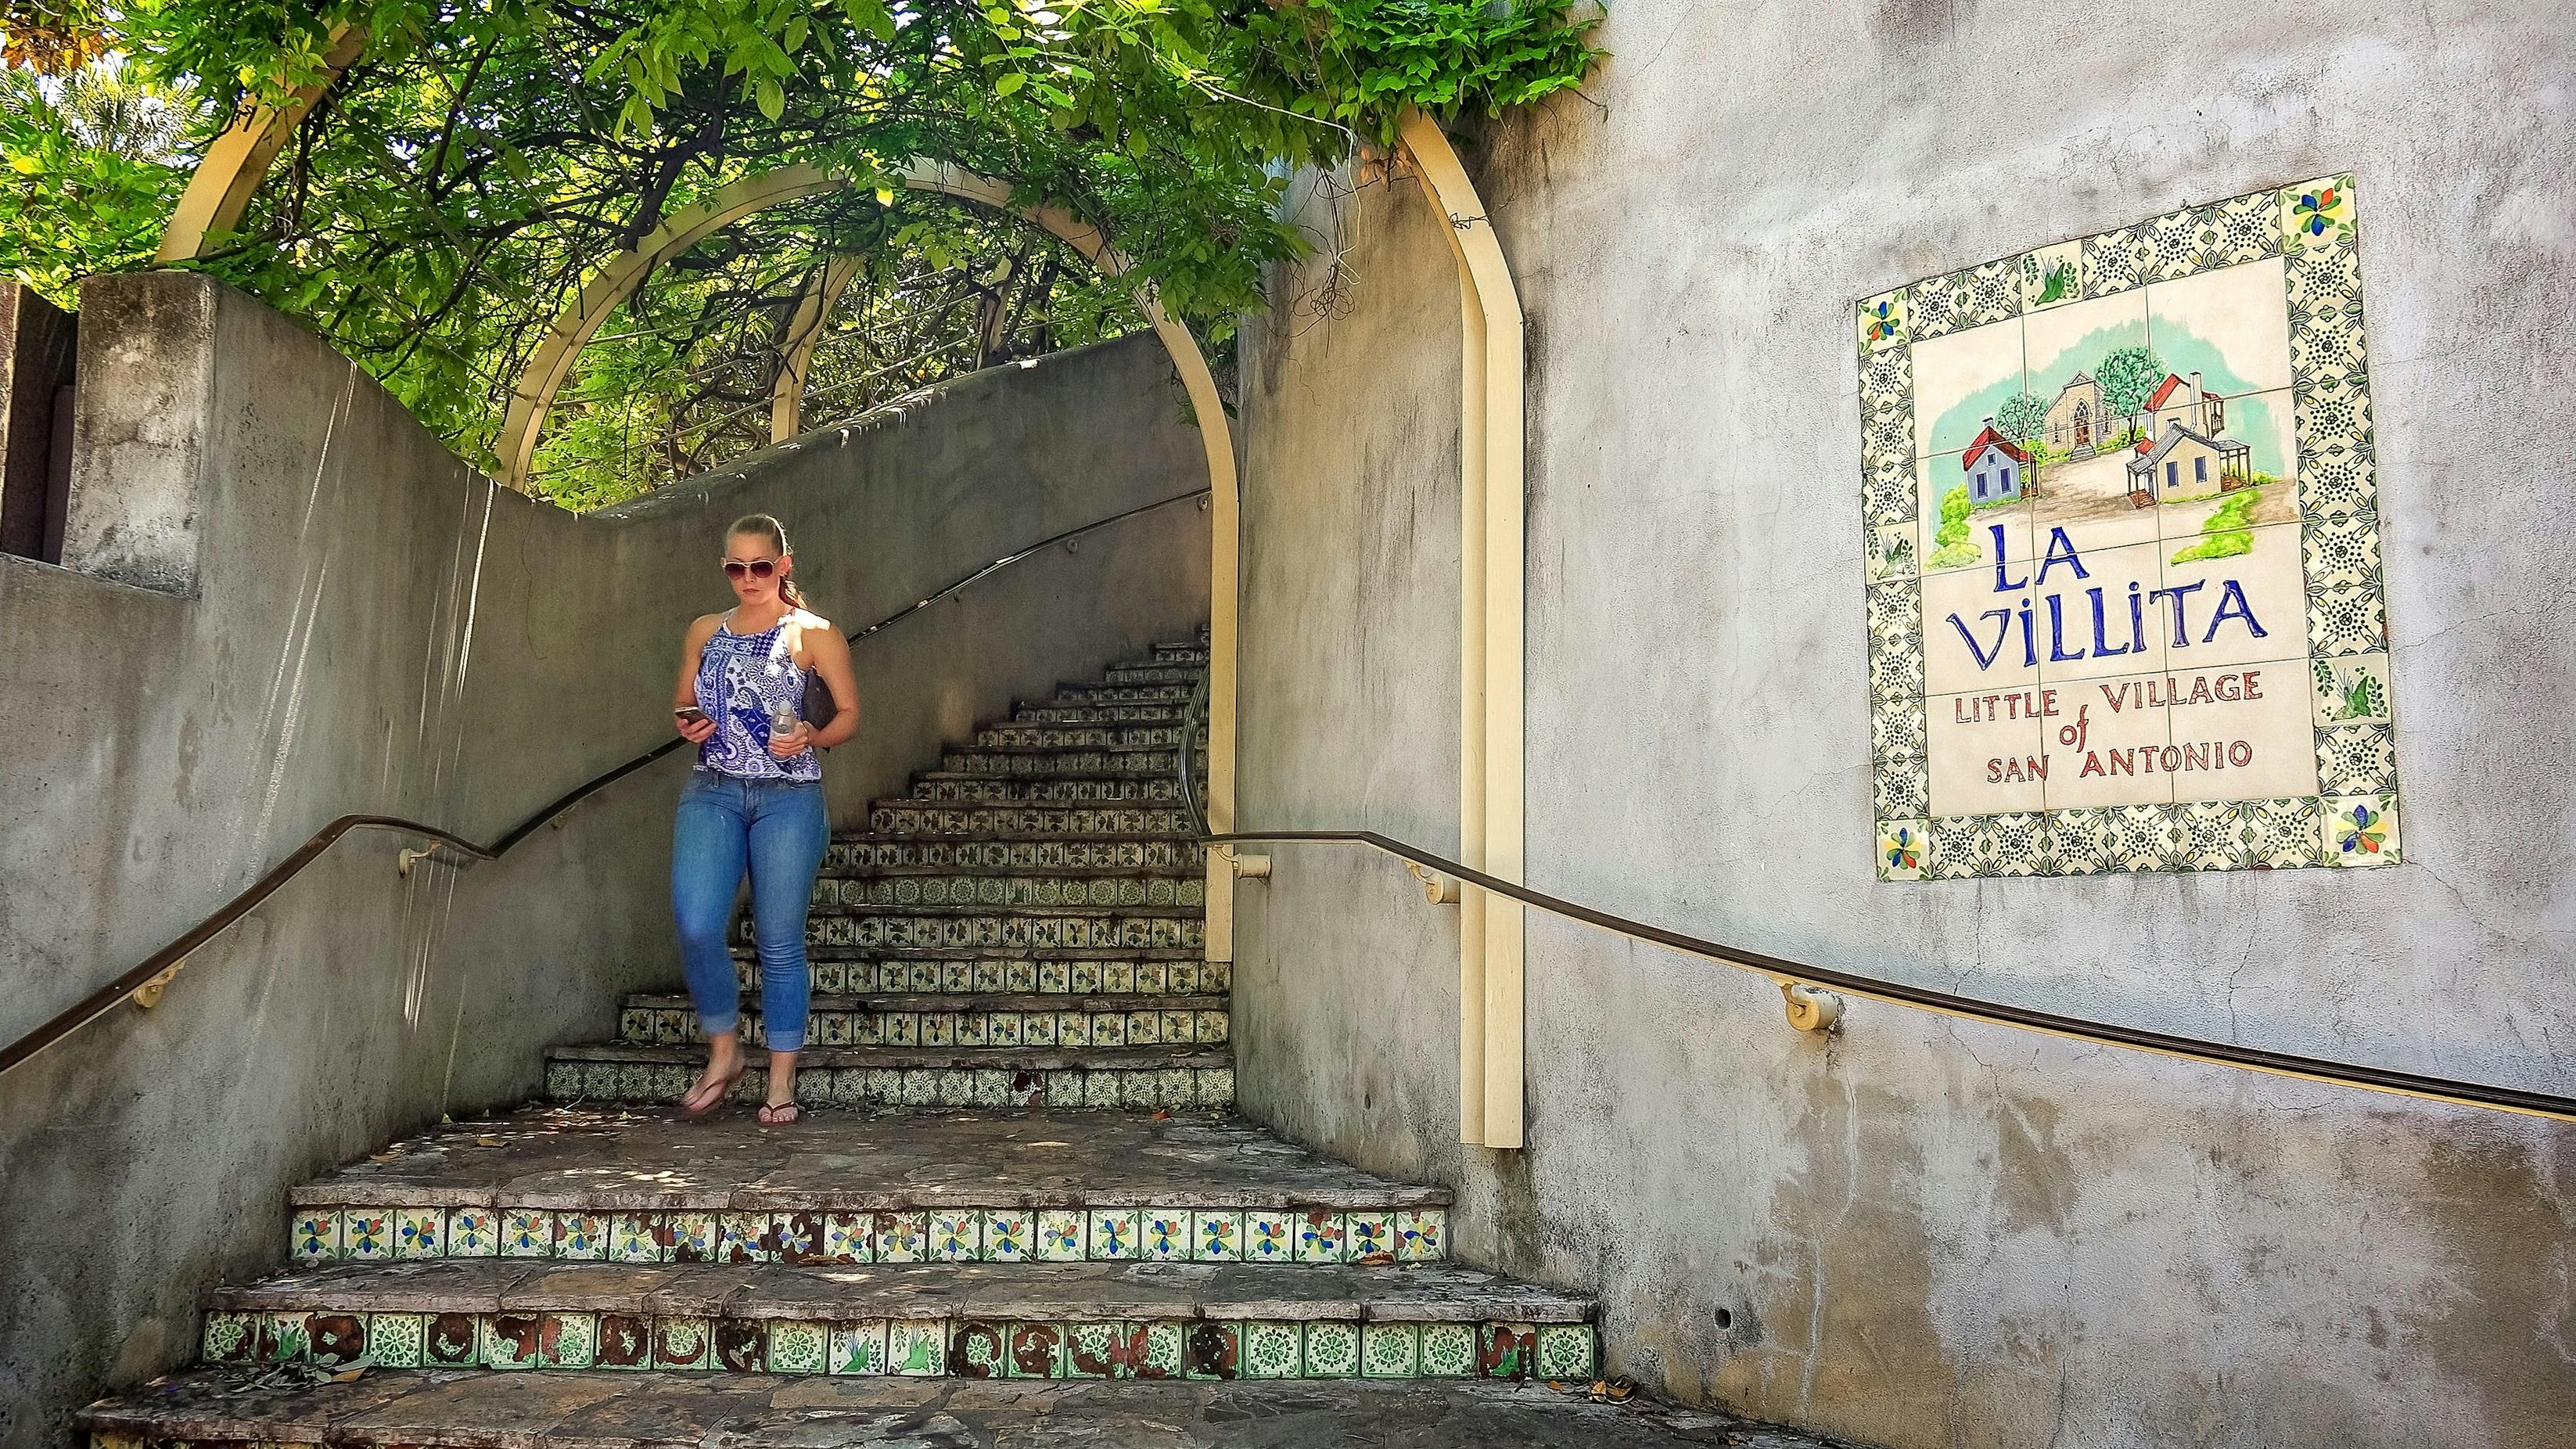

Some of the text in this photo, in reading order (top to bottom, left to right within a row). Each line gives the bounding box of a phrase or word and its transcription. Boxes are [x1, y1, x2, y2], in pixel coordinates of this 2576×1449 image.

[1989, 523, 2090, 592] LA
[1955, 671, 2263, 724] LITTLE VILLAGE
[2059, 704, 2089, 752] of
[1987, 740, 2254, 783] SAN ANTONIO
